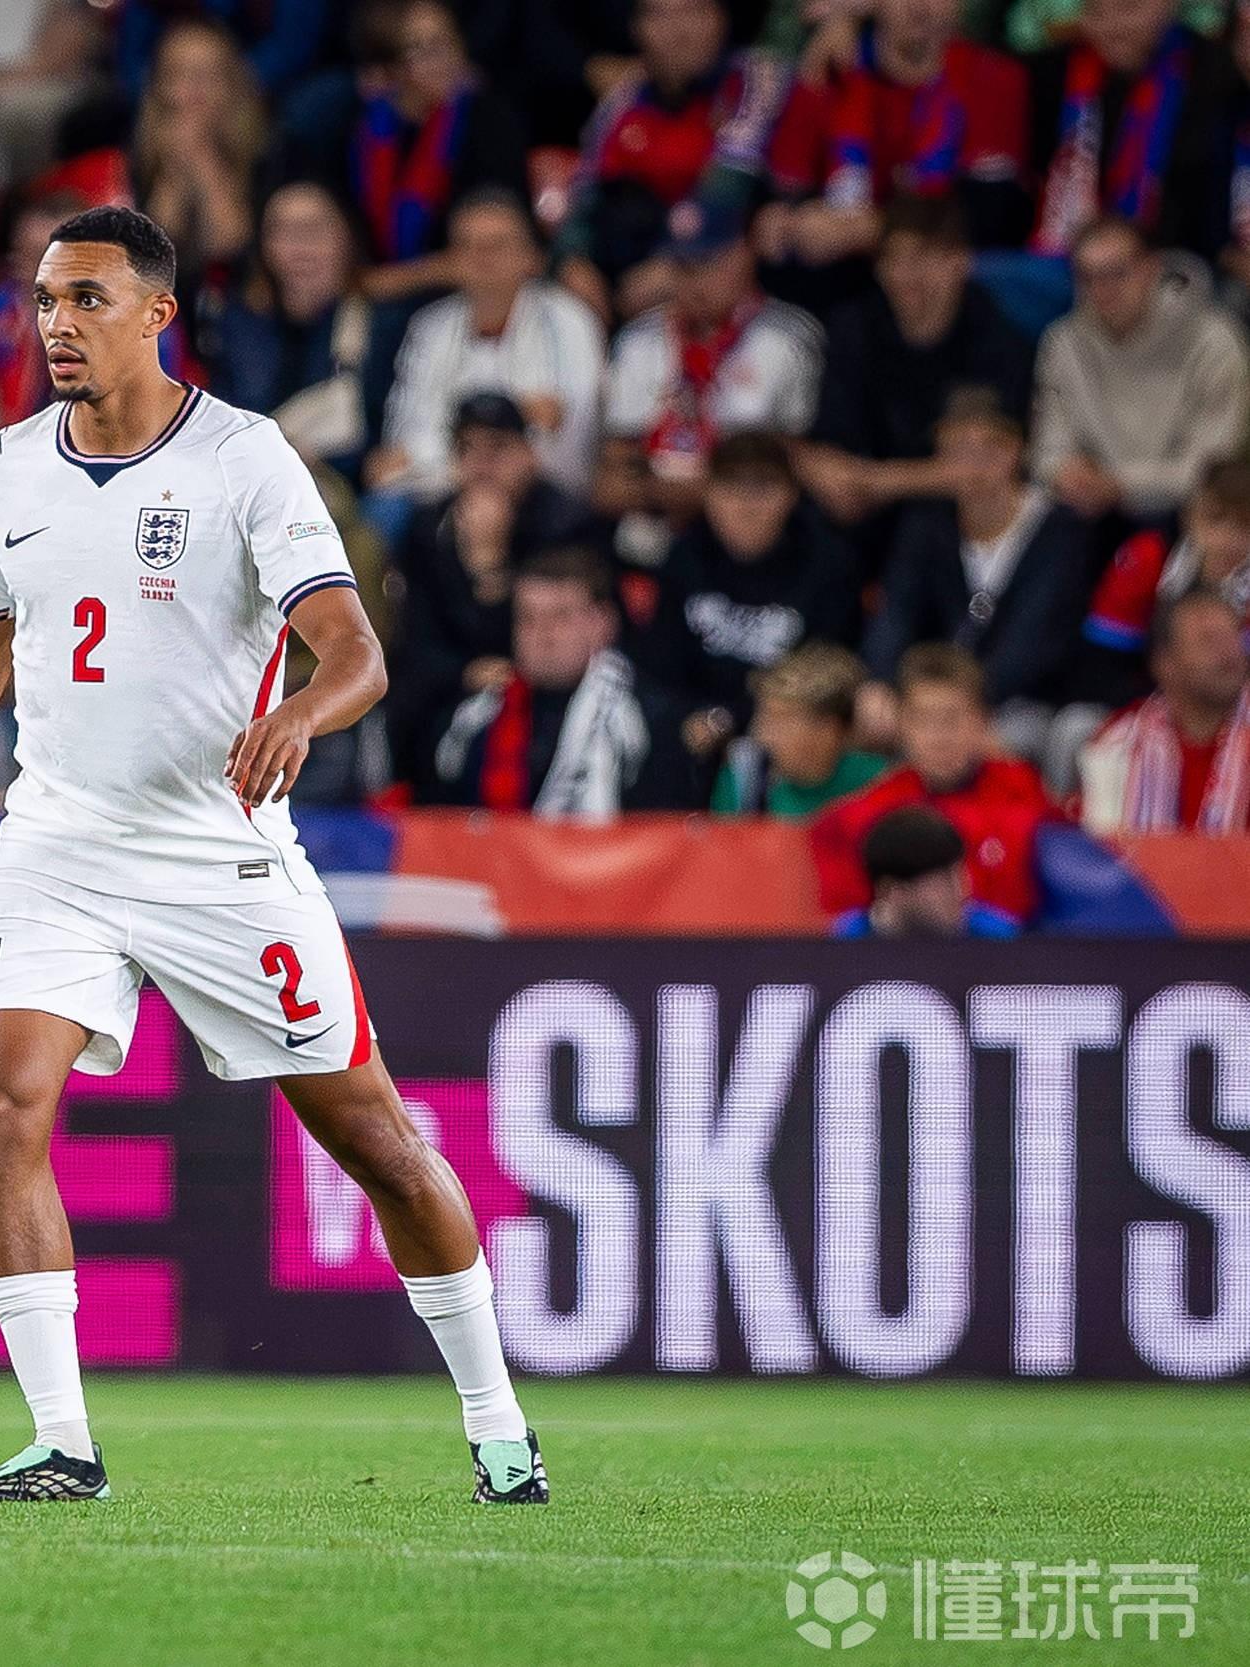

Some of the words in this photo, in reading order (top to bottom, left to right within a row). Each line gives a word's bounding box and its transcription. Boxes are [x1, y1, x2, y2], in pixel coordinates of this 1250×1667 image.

[72, 597, 106, 683] 2
[260, 942, 322, 1023] 2
[488, 978, 1250, 1380] SKOTS
